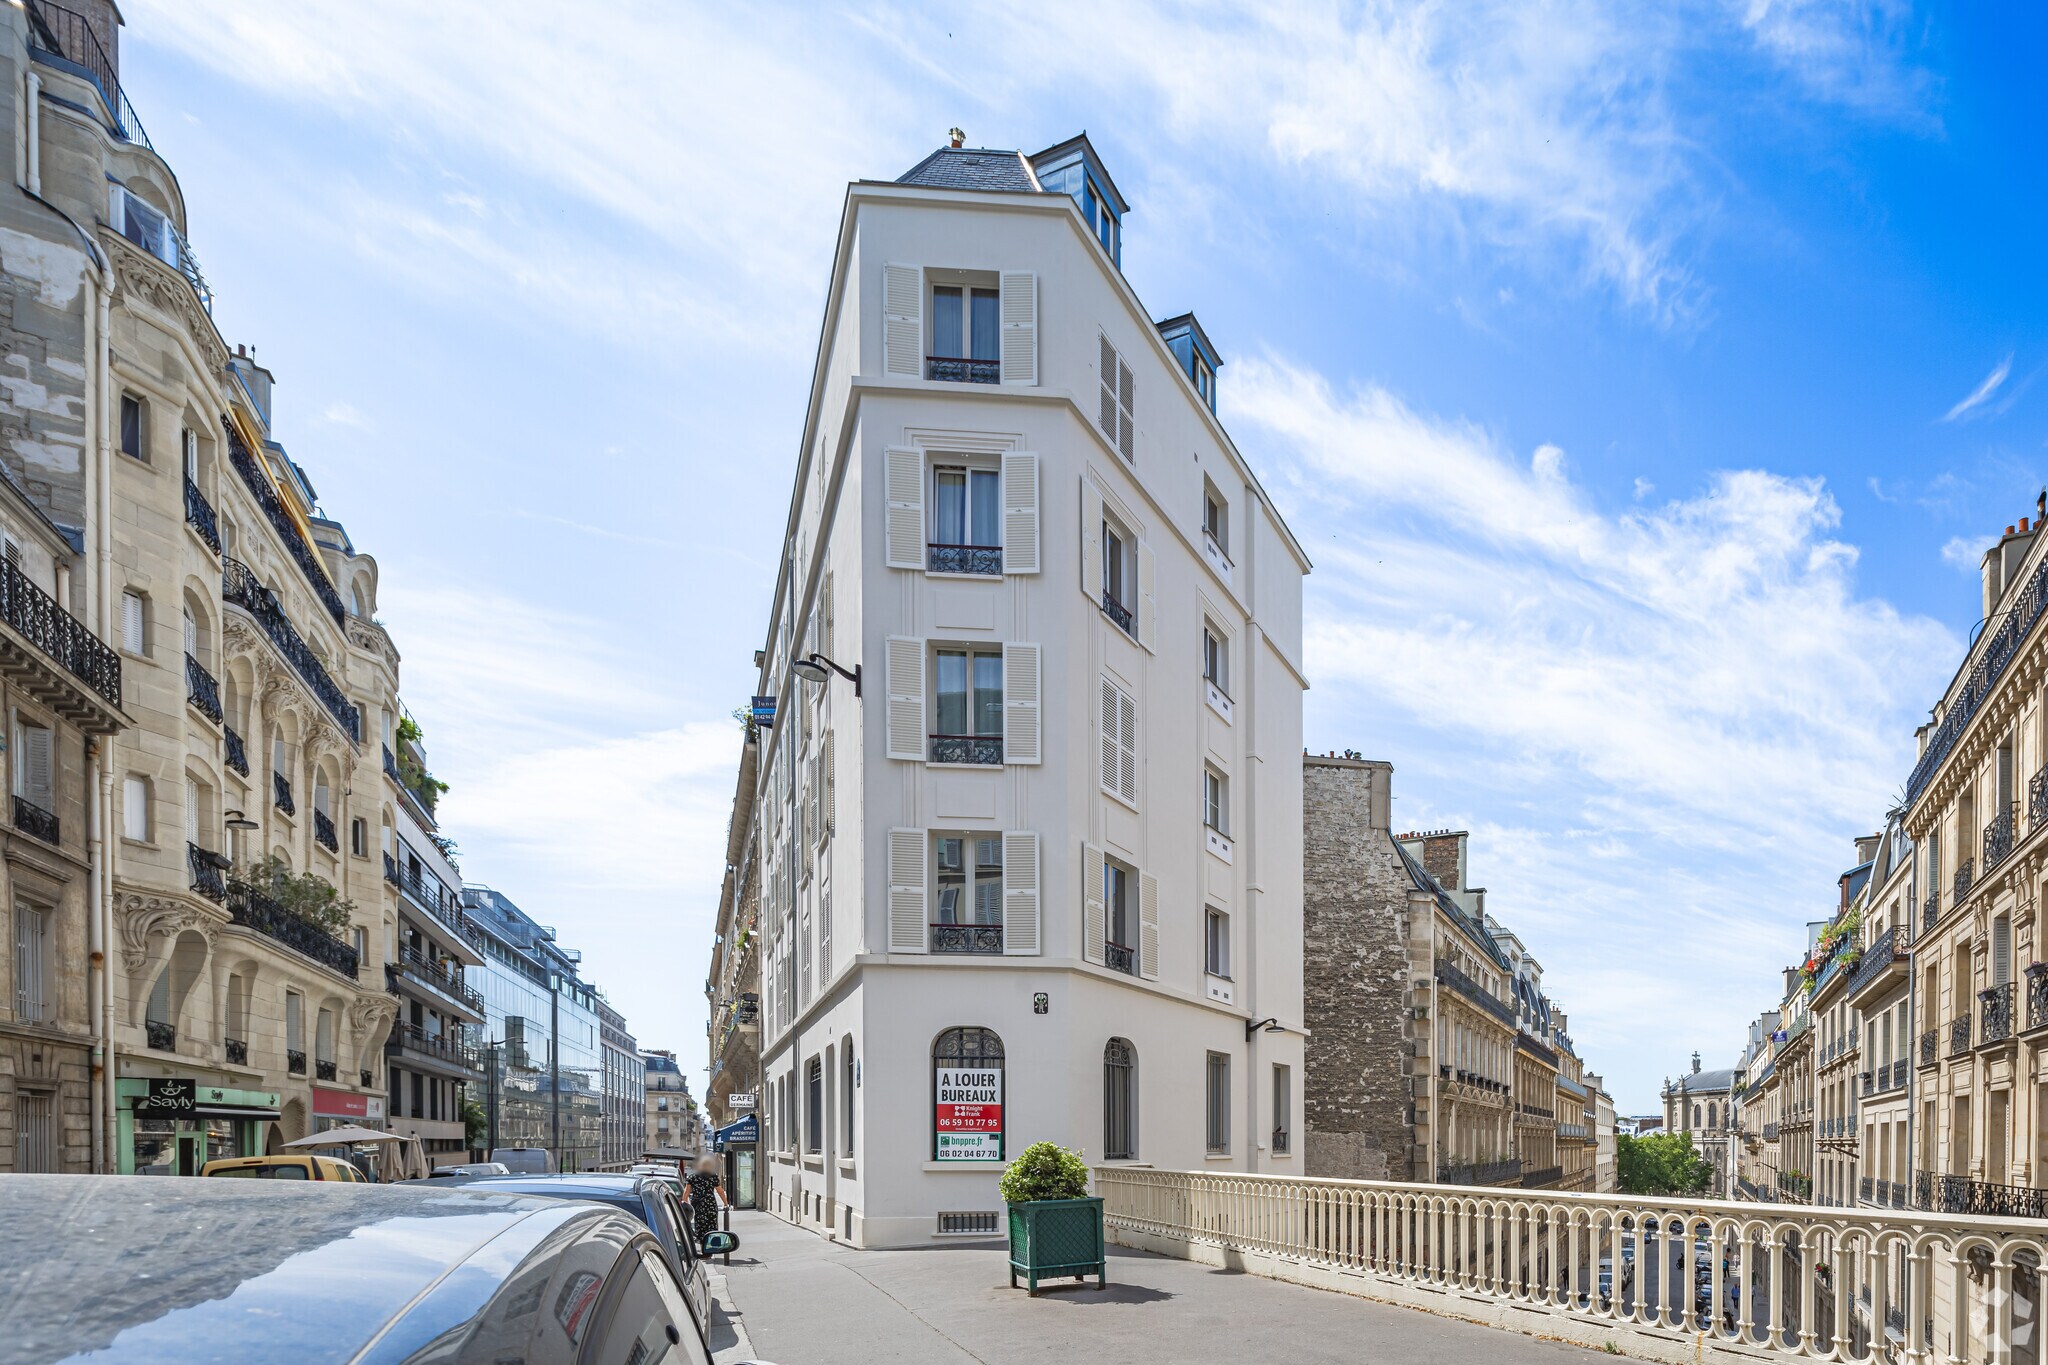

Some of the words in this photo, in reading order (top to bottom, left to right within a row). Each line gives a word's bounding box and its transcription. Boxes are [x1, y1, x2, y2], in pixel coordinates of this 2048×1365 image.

[942, 1073, 950, 1087] A
[955, 1073, 996, 1087] LOUER
[211, 1089, 224, 1101] Sayly
[731, 1094, 753, 1102] CAFÉ
[941, 1089, 996, 1102] BUREAUX
[150, 1095, 195, 1109] Sayly
[940, 1118, 950, 1126] 06
[952, 1118, 962, 1126] 59
[964, 1118, 974, 1126] 10
[976, 1118, 986, 1126] 77
[987, 1118, 998, 1126] 95
[951, 1136, 983, 1147] bnppre.fr
[940, 1150, 950, 1158] 06
[951, 1150, 962, 1158] 02
[964, 1150, 974, 1158] 04
[976, 1150, 986, 1158] 67
[987, 1150, 998, 1158] 70
